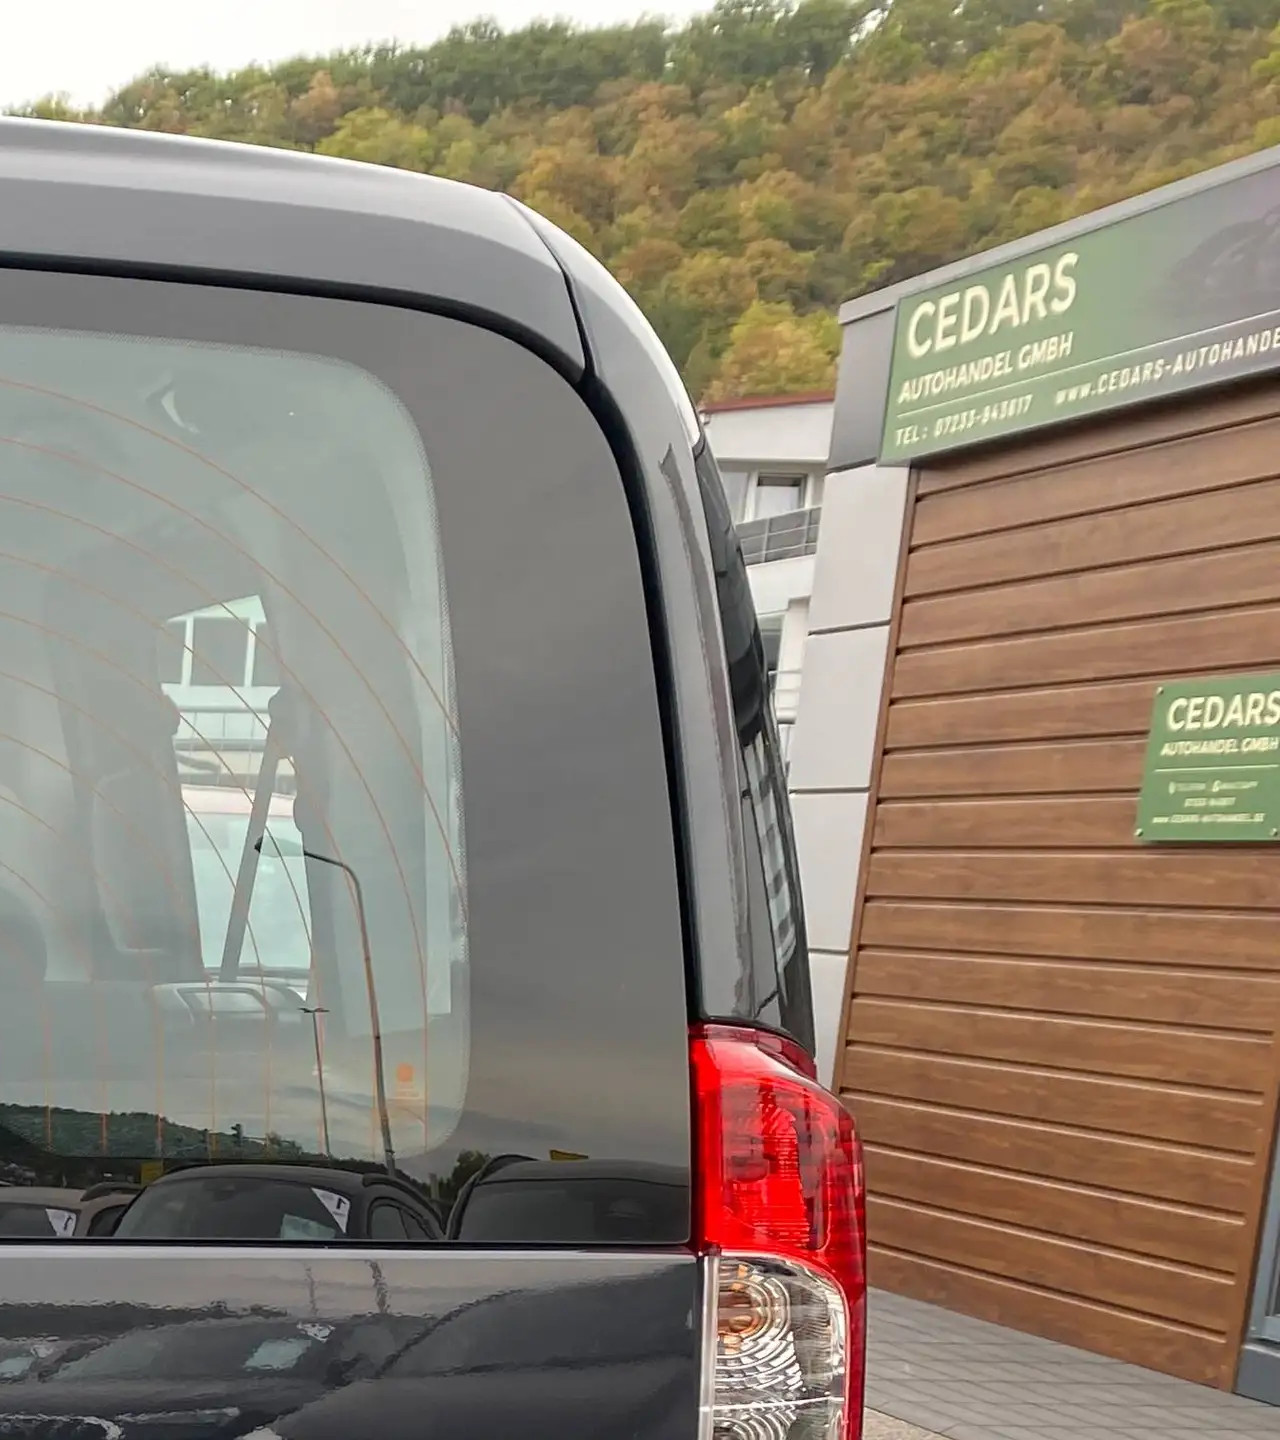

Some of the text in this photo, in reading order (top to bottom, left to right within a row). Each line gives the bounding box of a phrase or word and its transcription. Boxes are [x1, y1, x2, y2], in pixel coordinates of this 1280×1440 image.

[905, 252, 1079, 359] CEDARS
[898, 332, 1073, 405] AUTOHANDEL GMBH
[1166, 690, 1280, 732] CEDARS
[1160, 737, 1279, 756] AUTOHANDEL GMBH
